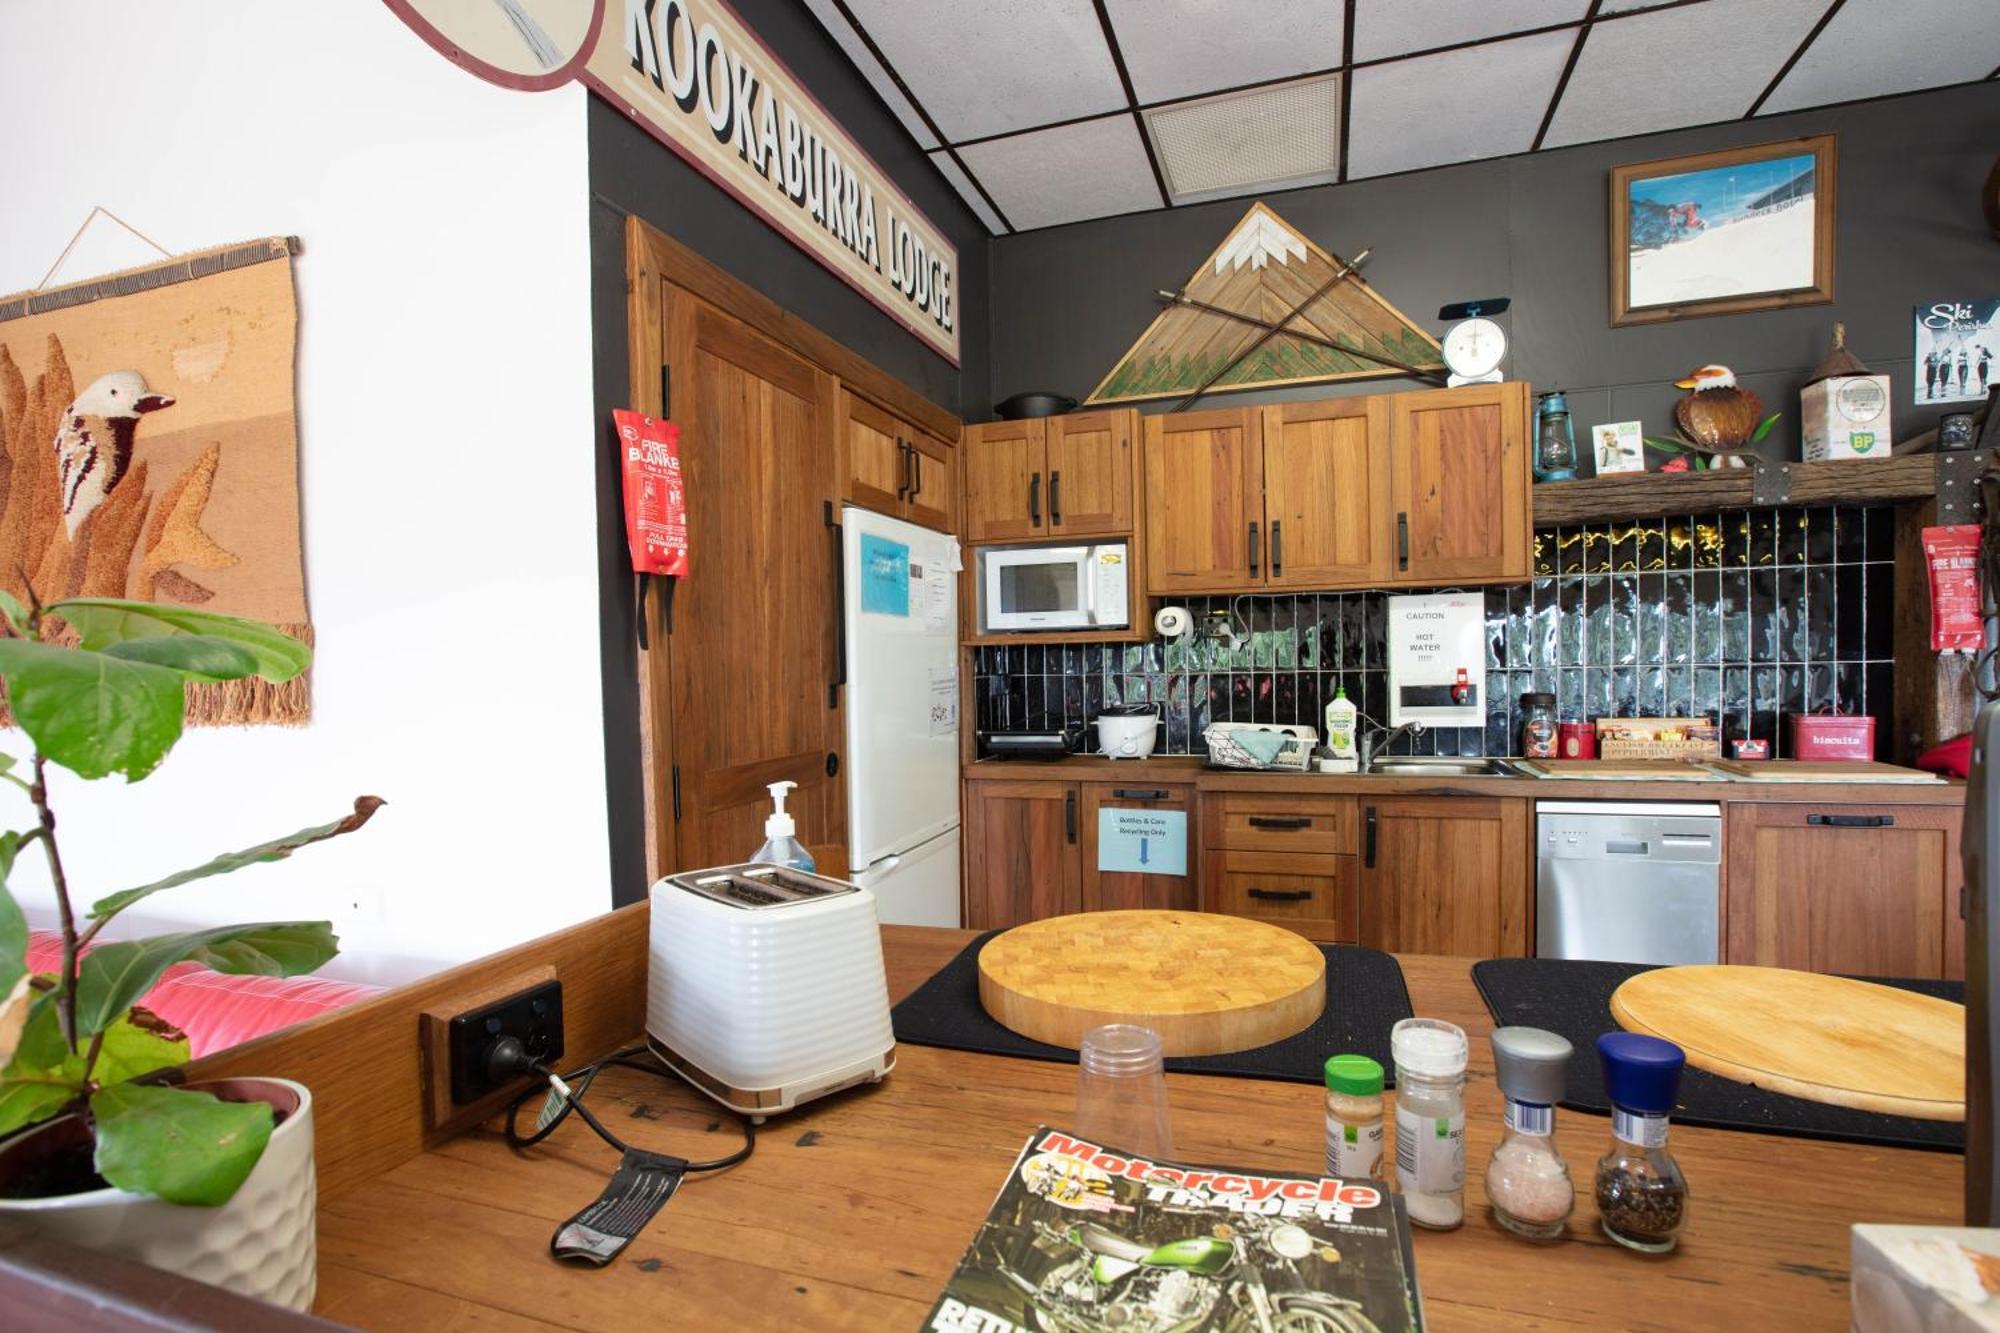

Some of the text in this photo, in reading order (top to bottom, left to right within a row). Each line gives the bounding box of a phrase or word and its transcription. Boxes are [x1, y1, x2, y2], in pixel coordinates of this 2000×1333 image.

[624, 0, 953, 333] KOOKABURRA LODGE
[1924, 303, 1974, 329] Ski
[641, 439, 668, 455] FIRE
[1854, 436, 1874, 449] BP
[628, 447, 681, 470] BLANKE
[1406, 612, 1445, 620] CAUTION
[1813, 735, 1860, 745] biscuits
[1120, 827, 1166, 836] Recycling Only
[1036, 1131, 1381, 1208] Motorcycle
